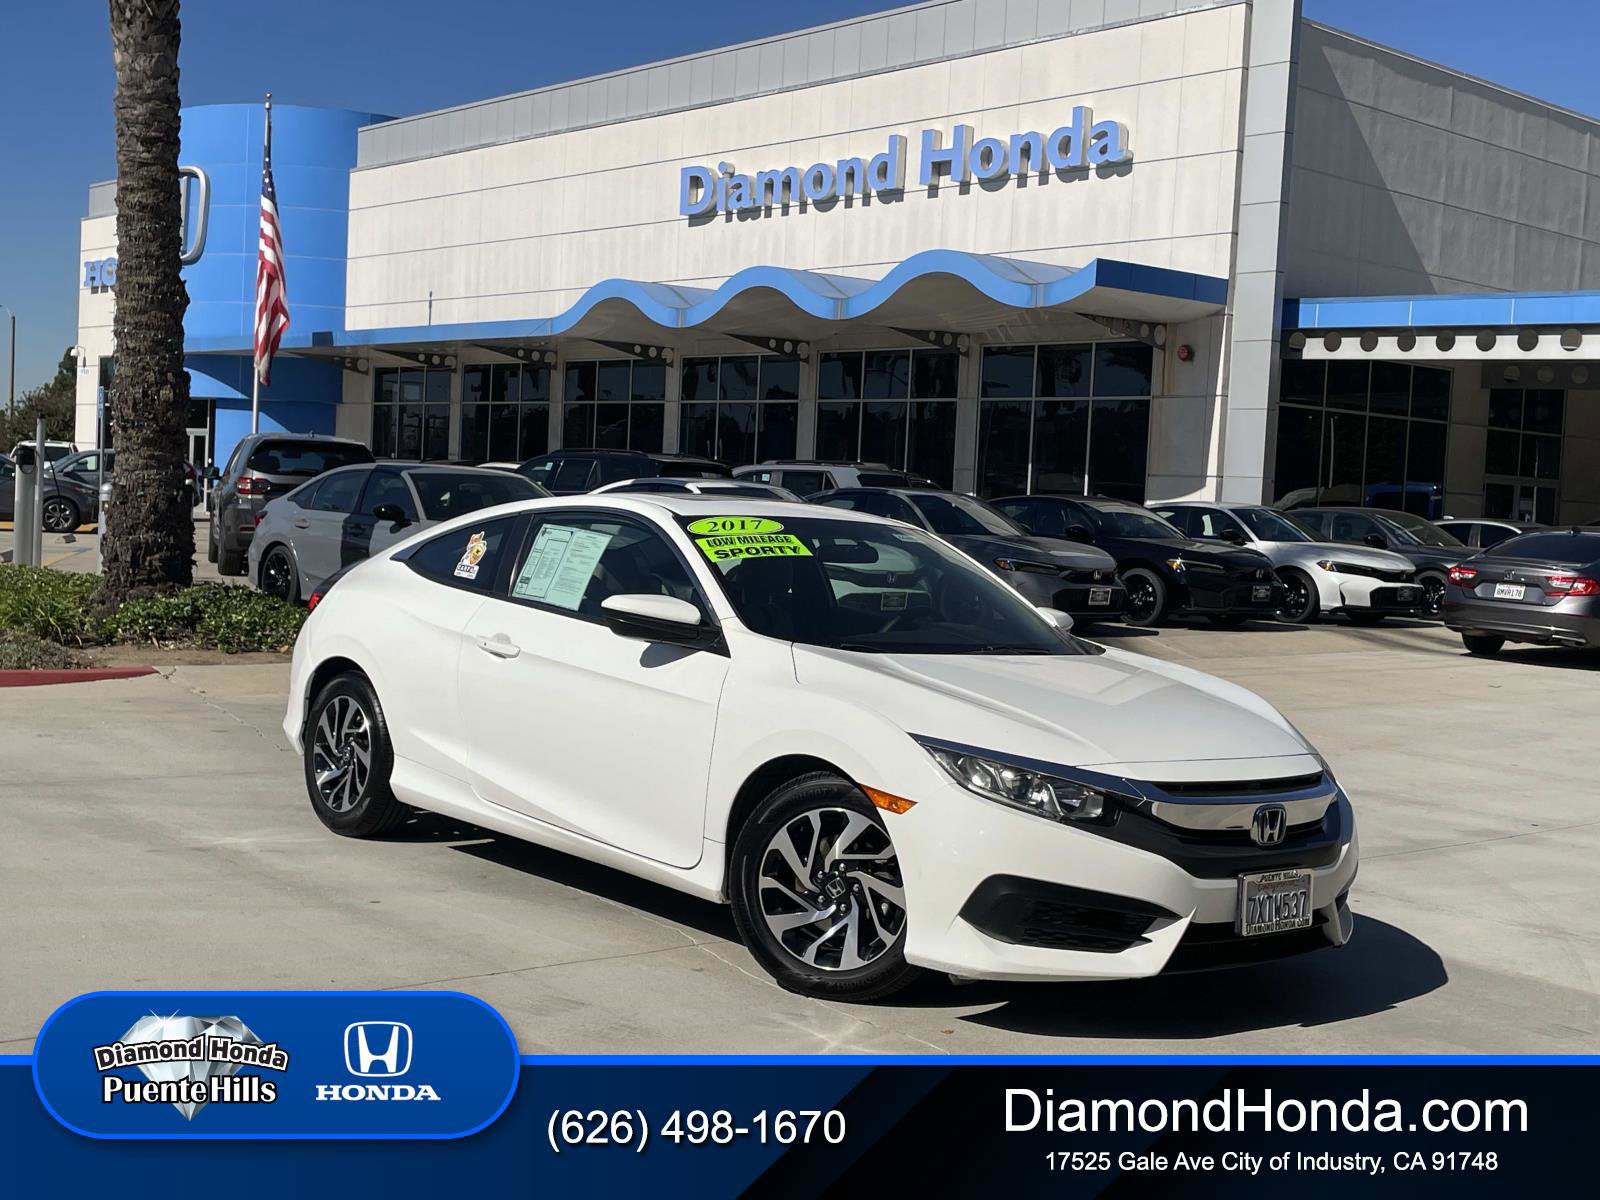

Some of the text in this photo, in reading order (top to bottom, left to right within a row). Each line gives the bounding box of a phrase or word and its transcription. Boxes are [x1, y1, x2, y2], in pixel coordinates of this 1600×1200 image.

[680, 105, 1129, 217] Diamond Honda
[706, 519, 763, 533] 2017
[706, 535, 793, 548] LOW MILEAGE
[714, 545, 800, 560] SPORTY
